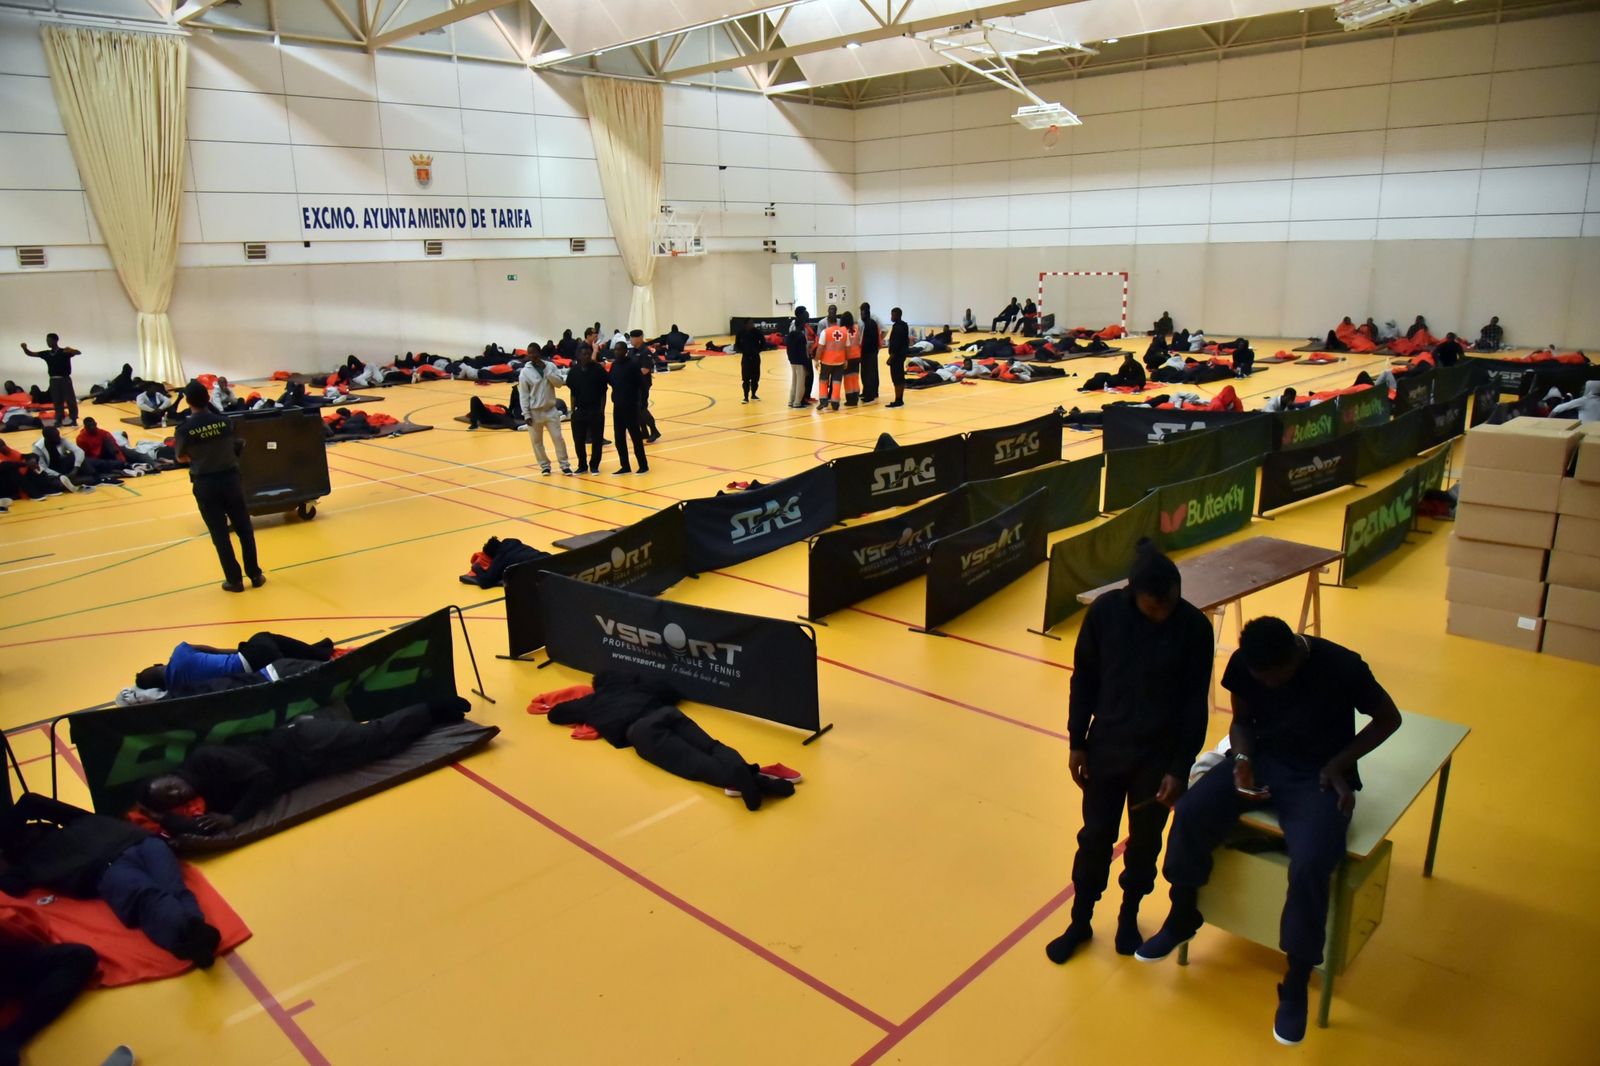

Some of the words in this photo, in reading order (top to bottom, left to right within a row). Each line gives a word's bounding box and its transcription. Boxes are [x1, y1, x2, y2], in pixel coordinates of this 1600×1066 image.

[302, 207, 358, 229] EXCMO.
[363, 207, 467, 229] AYUNTAMIENTO
[471, 208, 487, 228] DE
[491, 208, 533, 228] TARIFA
[188, 421, 227, 436] GUARDIA
[200, 429, 221, 439] CIVIL
[994, 431, 1040, 465] STAG
[871, 456, 936, 496] STAG
[730, 495, 803, 544] STAG
[1186, 484, 1245, 528] Butterfly
[572, 541, 653, 583] SPORT
[852, 522, 935, 566] VSPORT
[960, 523, 1024, 570] VSPORT
[595, 614, 743, 665] VSPORT
[602, 637, 667, 660] PROFESSIONAL
[674, 655, 703, 668] TABLE
[709, 662, 741, 679] TENNIS
[611, 652, 666, 670] www.vsport.es
